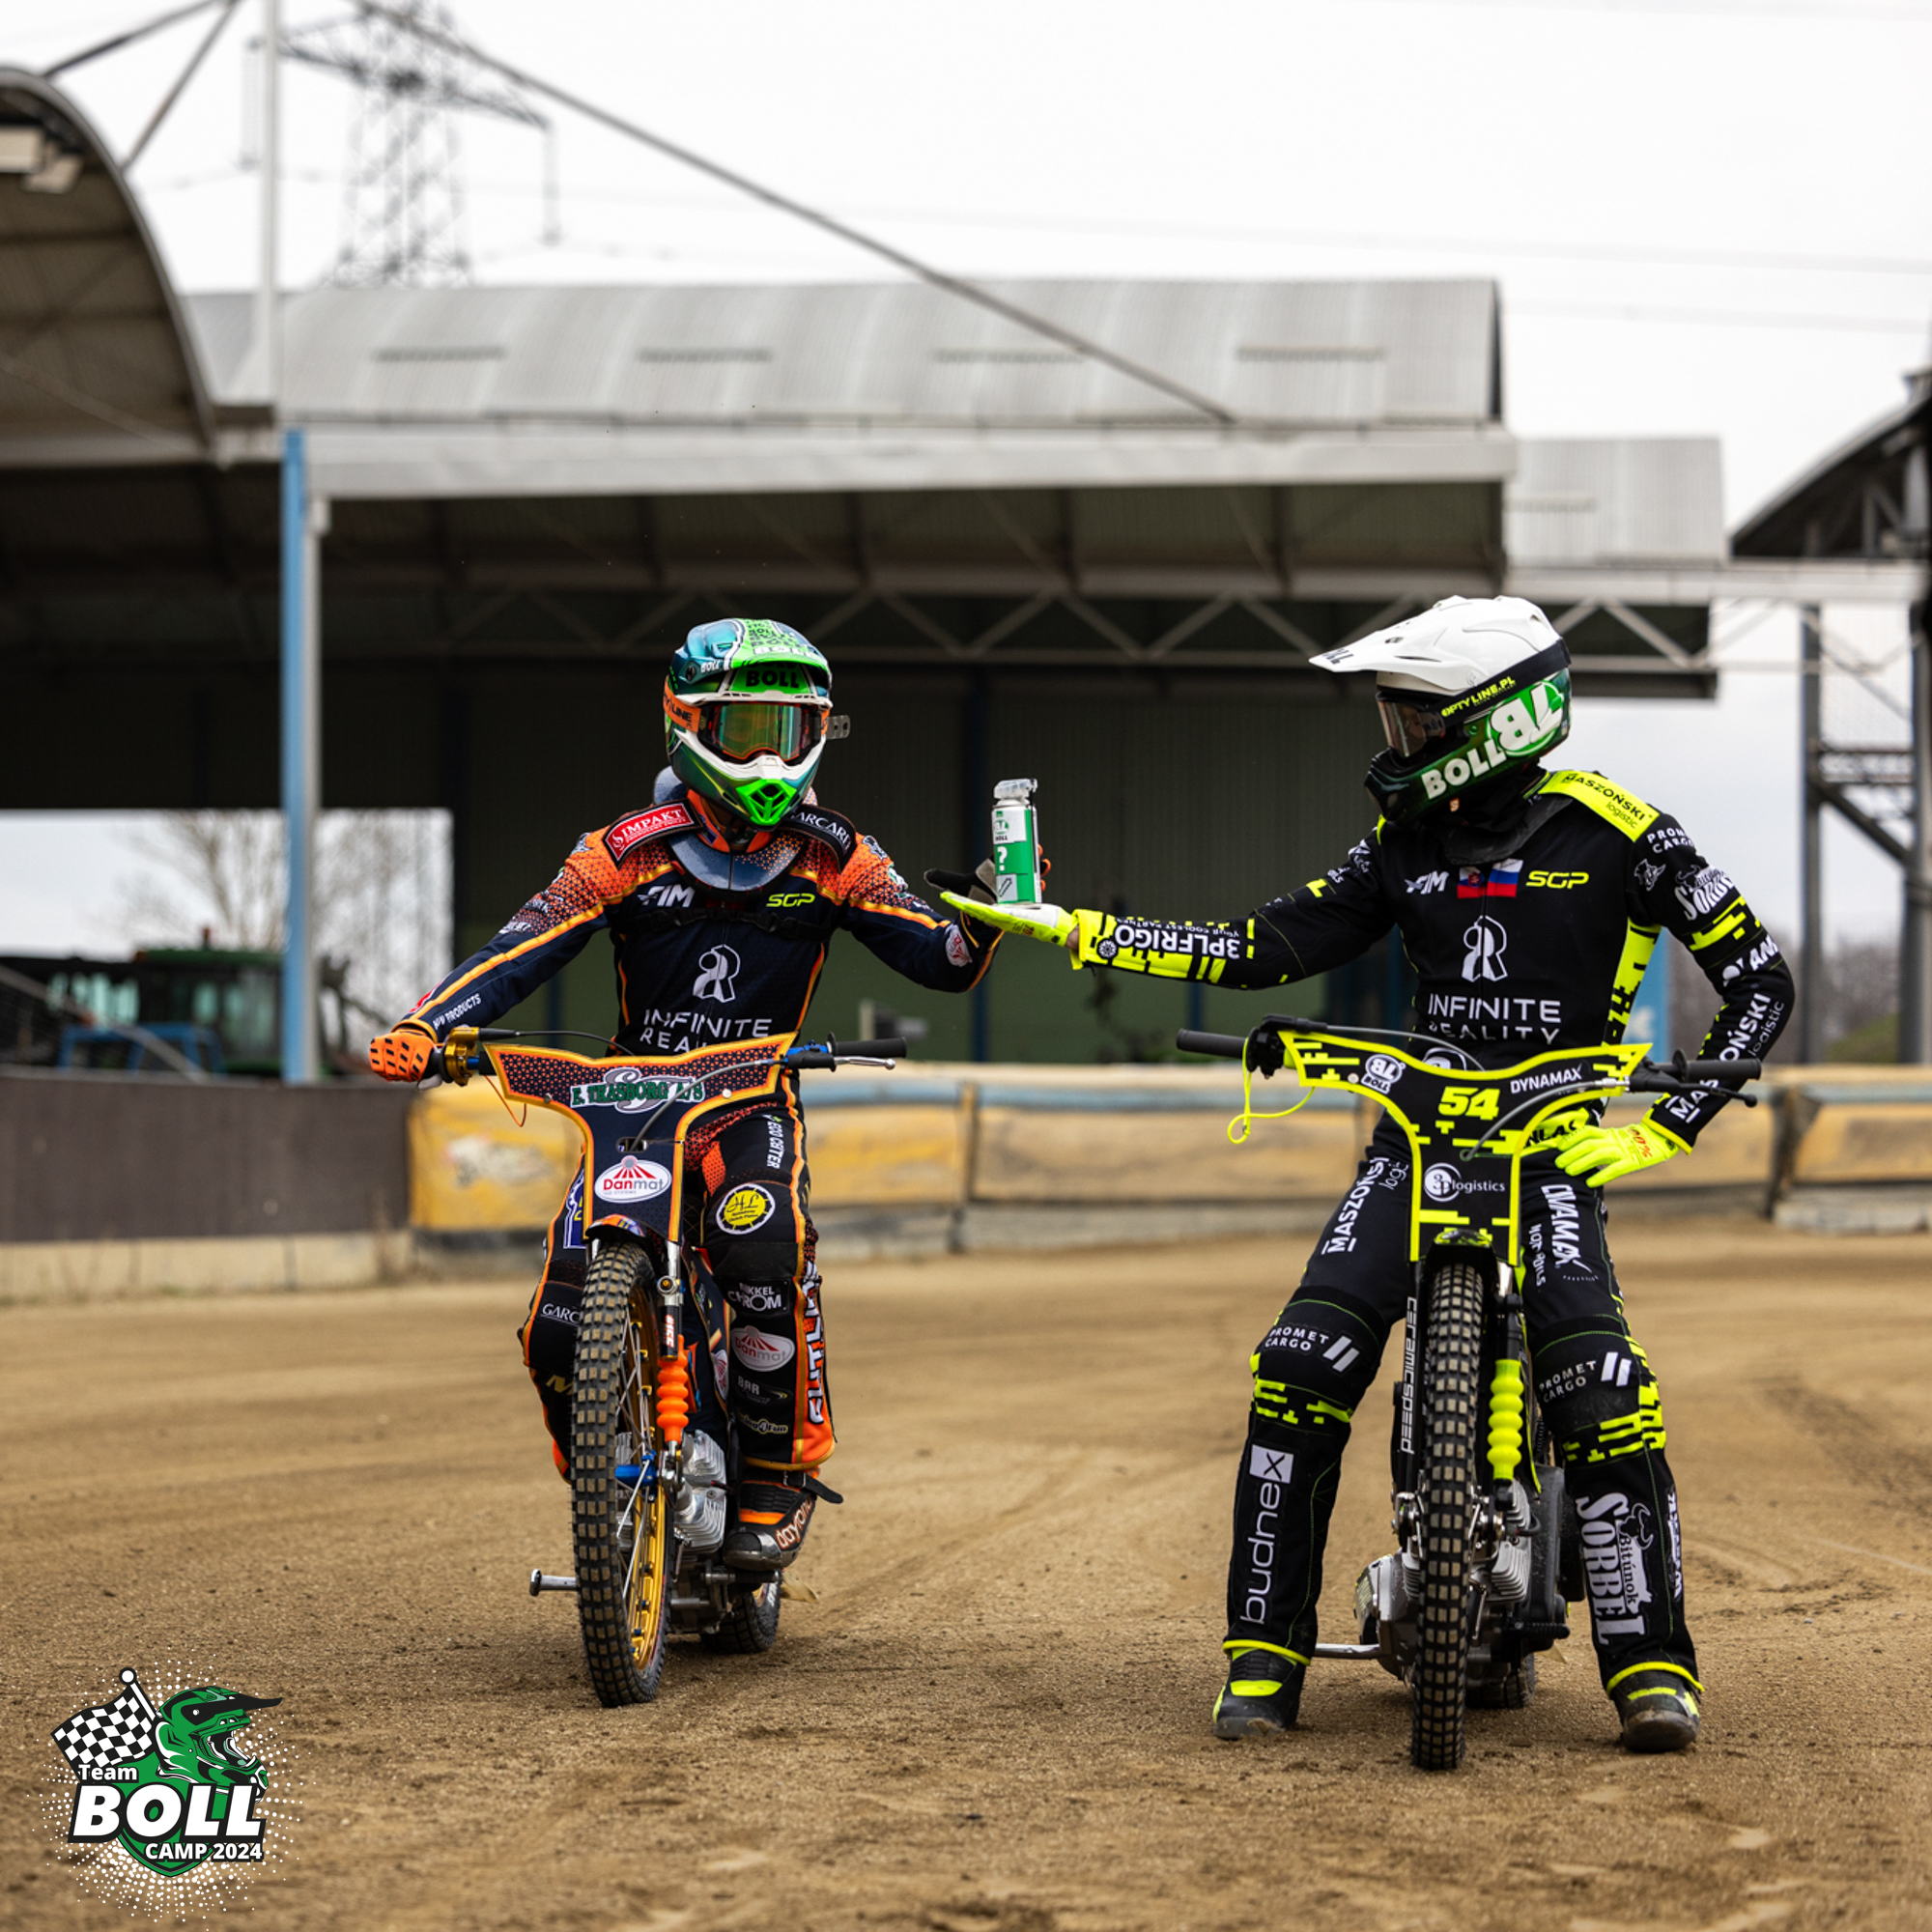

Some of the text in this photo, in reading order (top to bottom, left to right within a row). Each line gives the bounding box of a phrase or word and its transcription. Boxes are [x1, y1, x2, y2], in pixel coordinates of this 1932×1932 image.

[746, 669, 800, 689] BOLL
[1421, 738, 1507, 800] BOLL
[1605, 800, 1638, 829] logistic
[1526, 870, 1589, 889] SGP
[766, 893, 815, 907] SGP
[1114, 924, 1240, 959] 3PLFRIGO
[1428, 993, 1561, 1023] INFINITE
[643, 1009, 772, 1038] INFINITE
[586, 1081, 668, 1102] TRASBORG
[1510, 1064, 1582, 1094] DYNAMAX
[1438, 1087, 1501, 1121] 54
[604, 1179, 665, 1190] Danmat
[541, 1303, 579, 1323] GARC
[727, 1291, 781, 1312] CHROM
[735, 1337, 786, 1361] Danmat
[1264, 1337, 1312, 1351] CARGO
[1539, 1360, 1596, 1390] PROMET
[1544, 1376, 1586, 1403] CARGO
